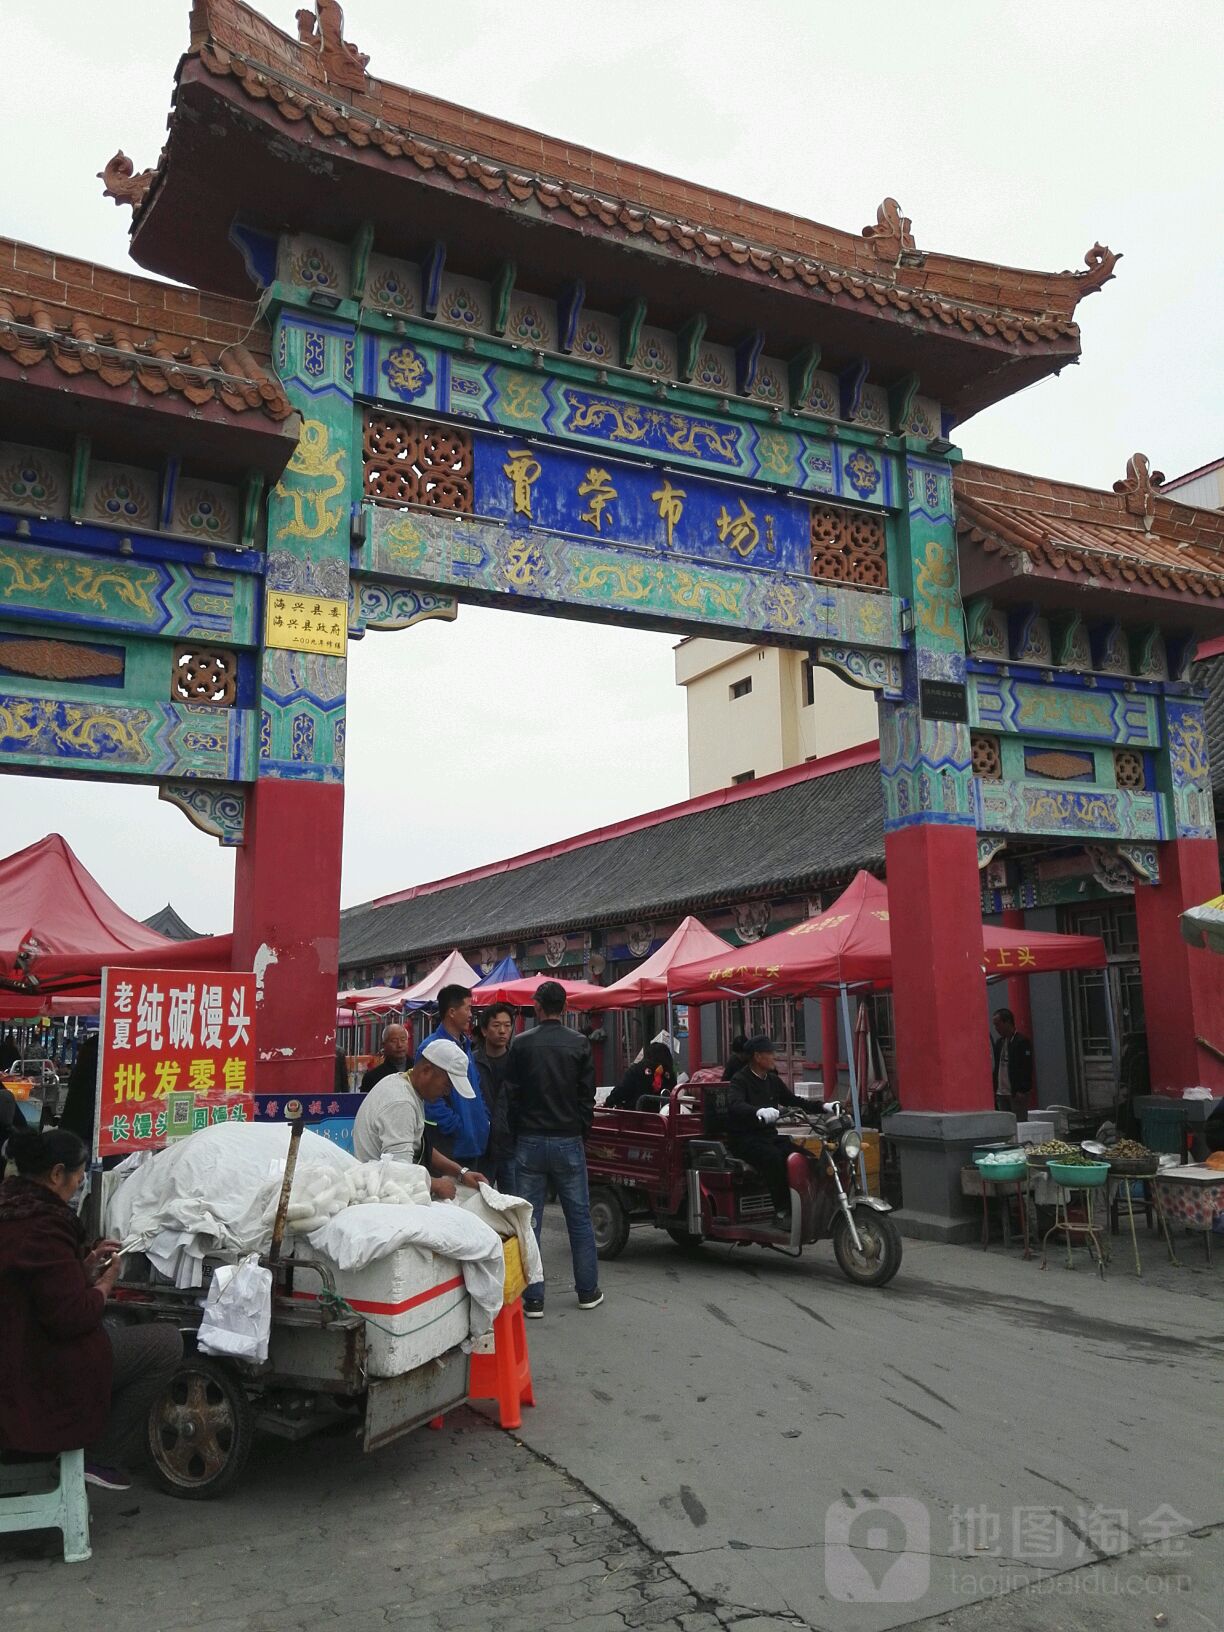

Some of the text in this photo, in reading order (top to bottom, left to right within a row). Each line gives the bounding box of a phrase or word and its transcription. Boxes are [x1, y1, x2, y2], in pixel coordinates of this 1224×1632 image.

[274, 598, 341, 618] 海兴县委
[273, 615, 341, 636] 海兴县政府
[984, 947, 1037, 967] 上头
[112, 981, 134, 1050] 老夏
[136, 984, 250, 1050] 纯碱馒头
[114, 1056, 248, 1104] 批发零售
